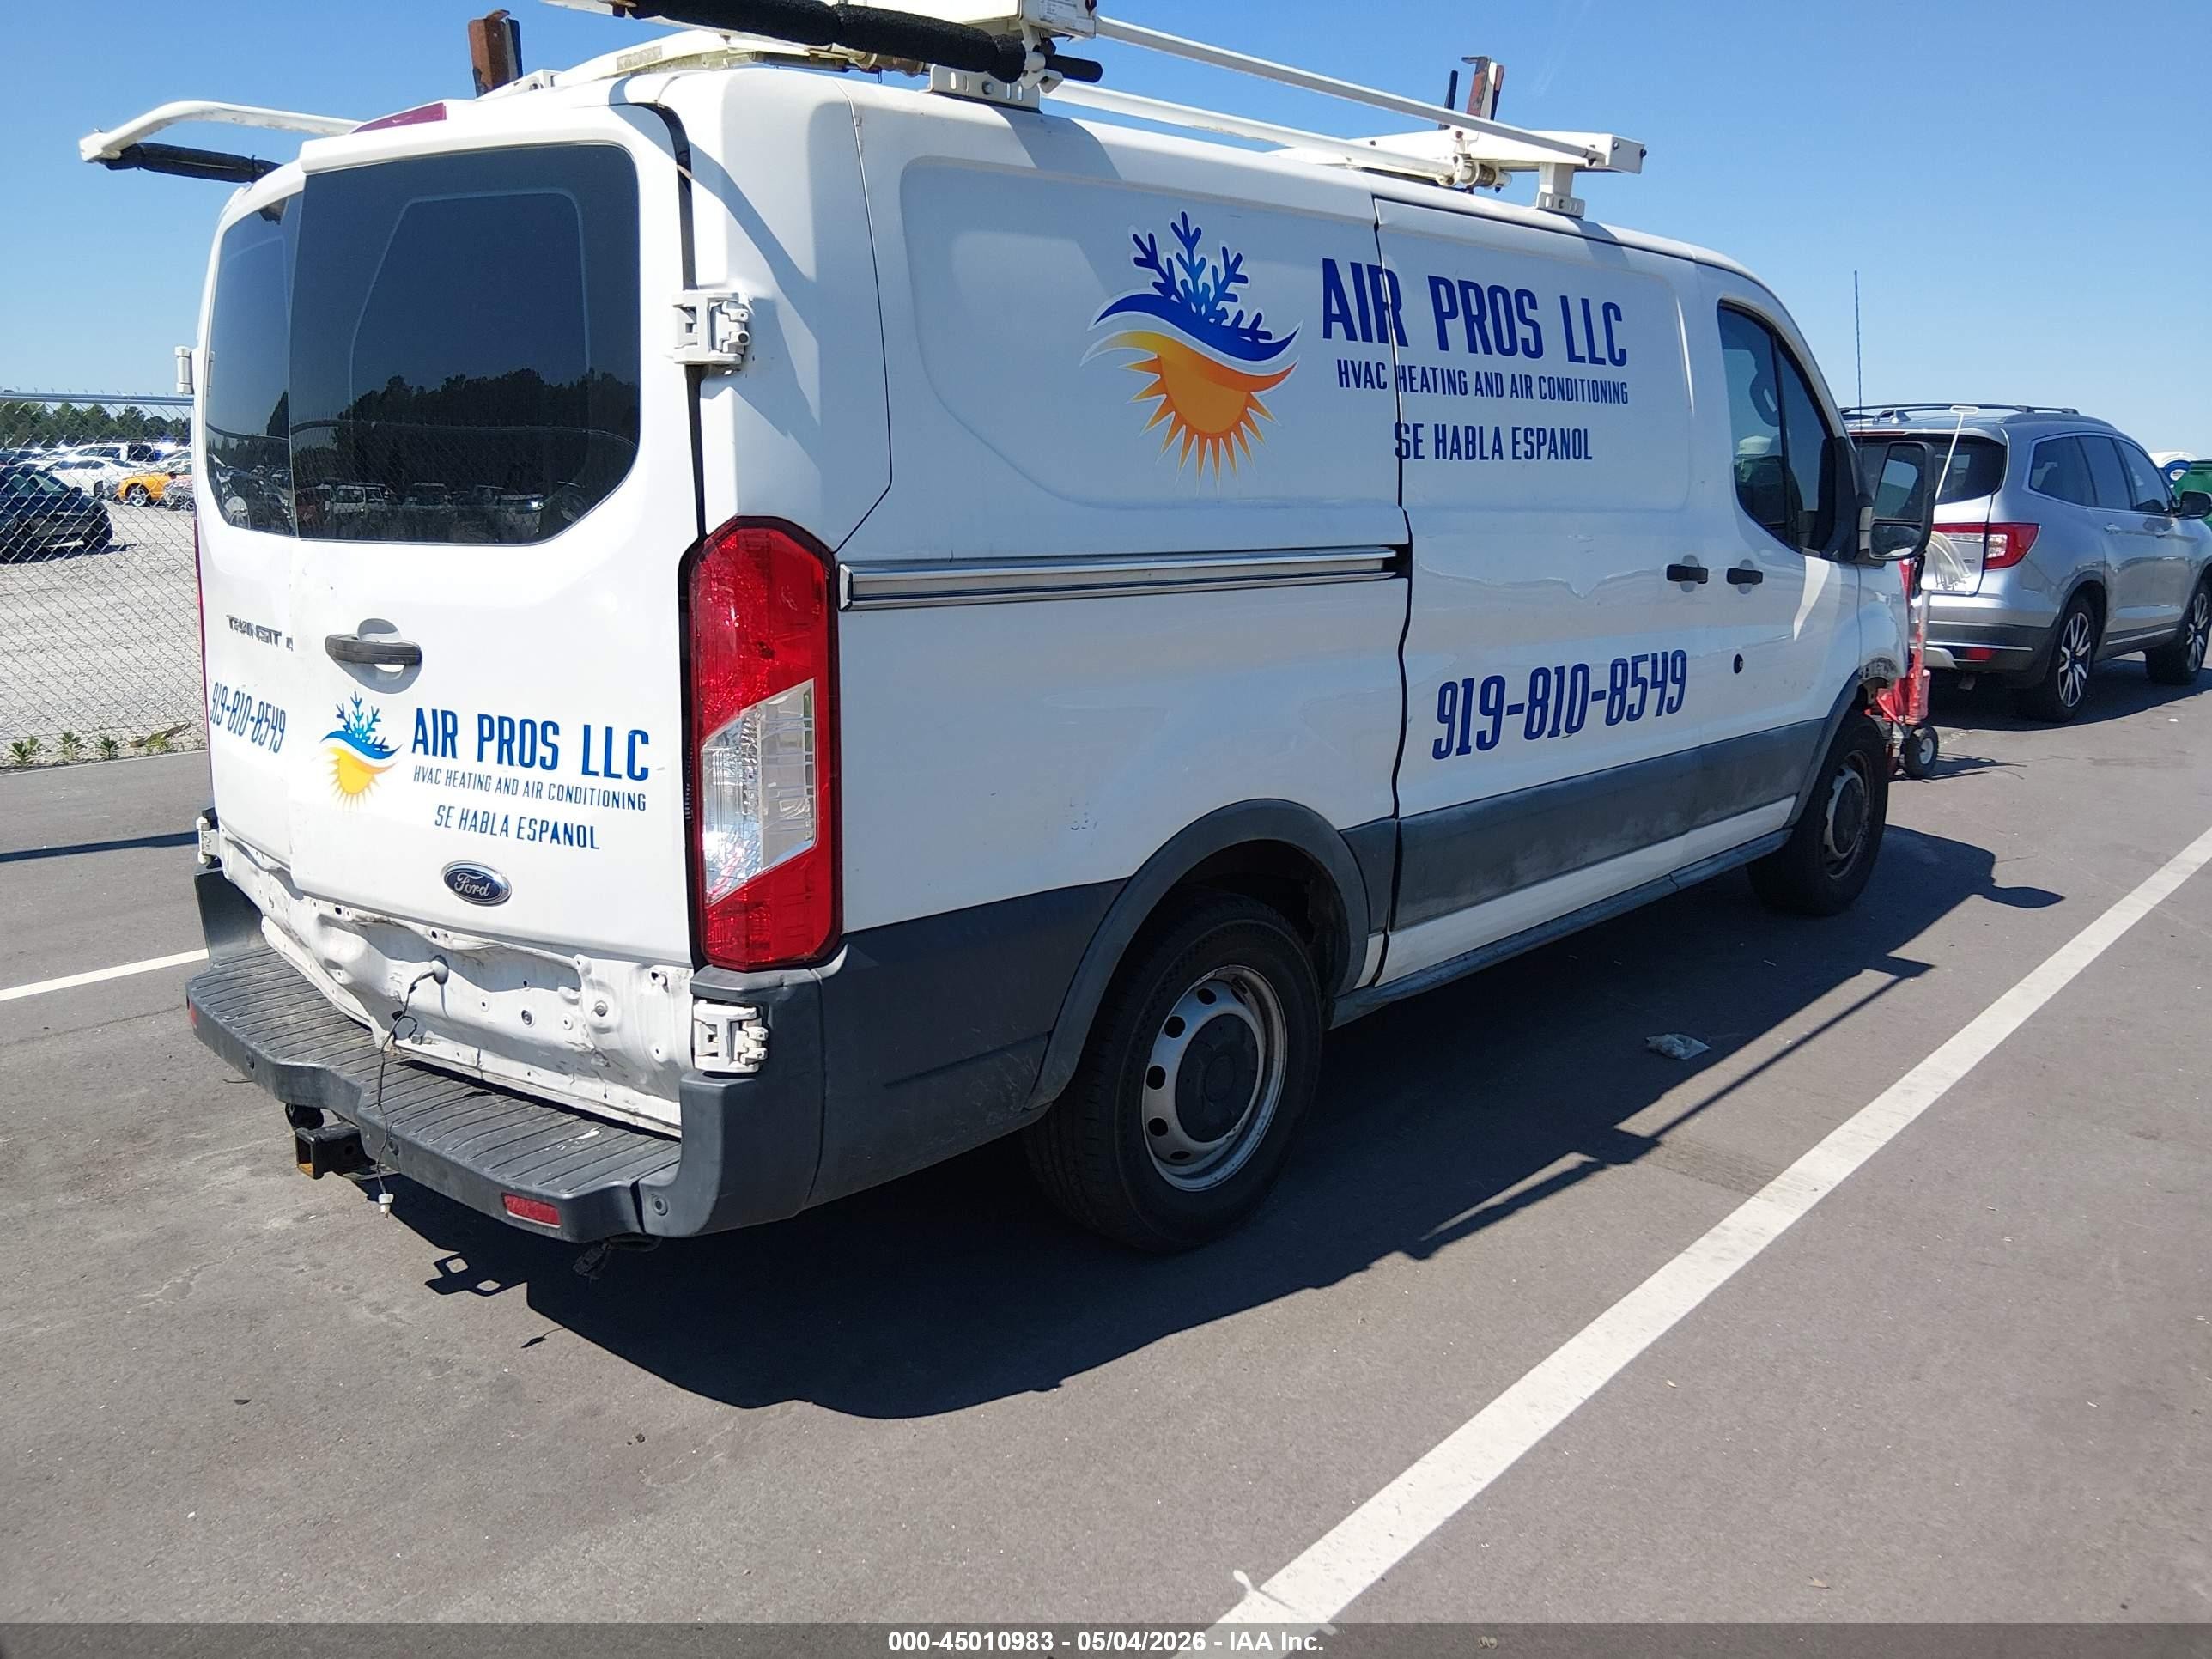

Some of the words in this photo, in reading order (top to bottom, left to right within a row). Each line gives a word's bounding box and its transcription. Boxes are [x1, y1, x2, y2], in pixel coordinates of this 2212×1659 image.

[1322, 258, 1408, 347] AIR
[1428, 275, 1544, 359] PROS
[1559, 295, 1627, 367] LLC
[1337, 358, 1388, 390] HVAC
[1396, 364, 1468, 397] HEATING
[1474, 371, 1504, 398] AND
[1510, 373, 1534, 400] AIR
[1539, 375, 1629, 405] CONDITIONING
[1394, 422, 1425, 460] SE
[1434, 423, 1504, 461] HABLA
[1511, 426, 1593, 461] ESPANOL
[210, 681, 287, 754] 919-810-8549
[1431, 649, 1687, 760] 919-810-8549
[411, 708, 458, 759] AIR
[477, 714, 560, 770] PROS
[581, 724, 650, 781] LLC
[413, 765, 441, 785] HVAC
[445, 769, 492, 793] HEATING
[495, 776, 520, 796] AND
[522, 780, 544, 799] AIR
[548, 783, 647, 811] CONDITIONING
[434, 804, 455, 829] SE
[458, 807, 509, 837] HABLA
[516, 817, 600, 849] ESPANOL
[453, 872, 491, 896] Ford
